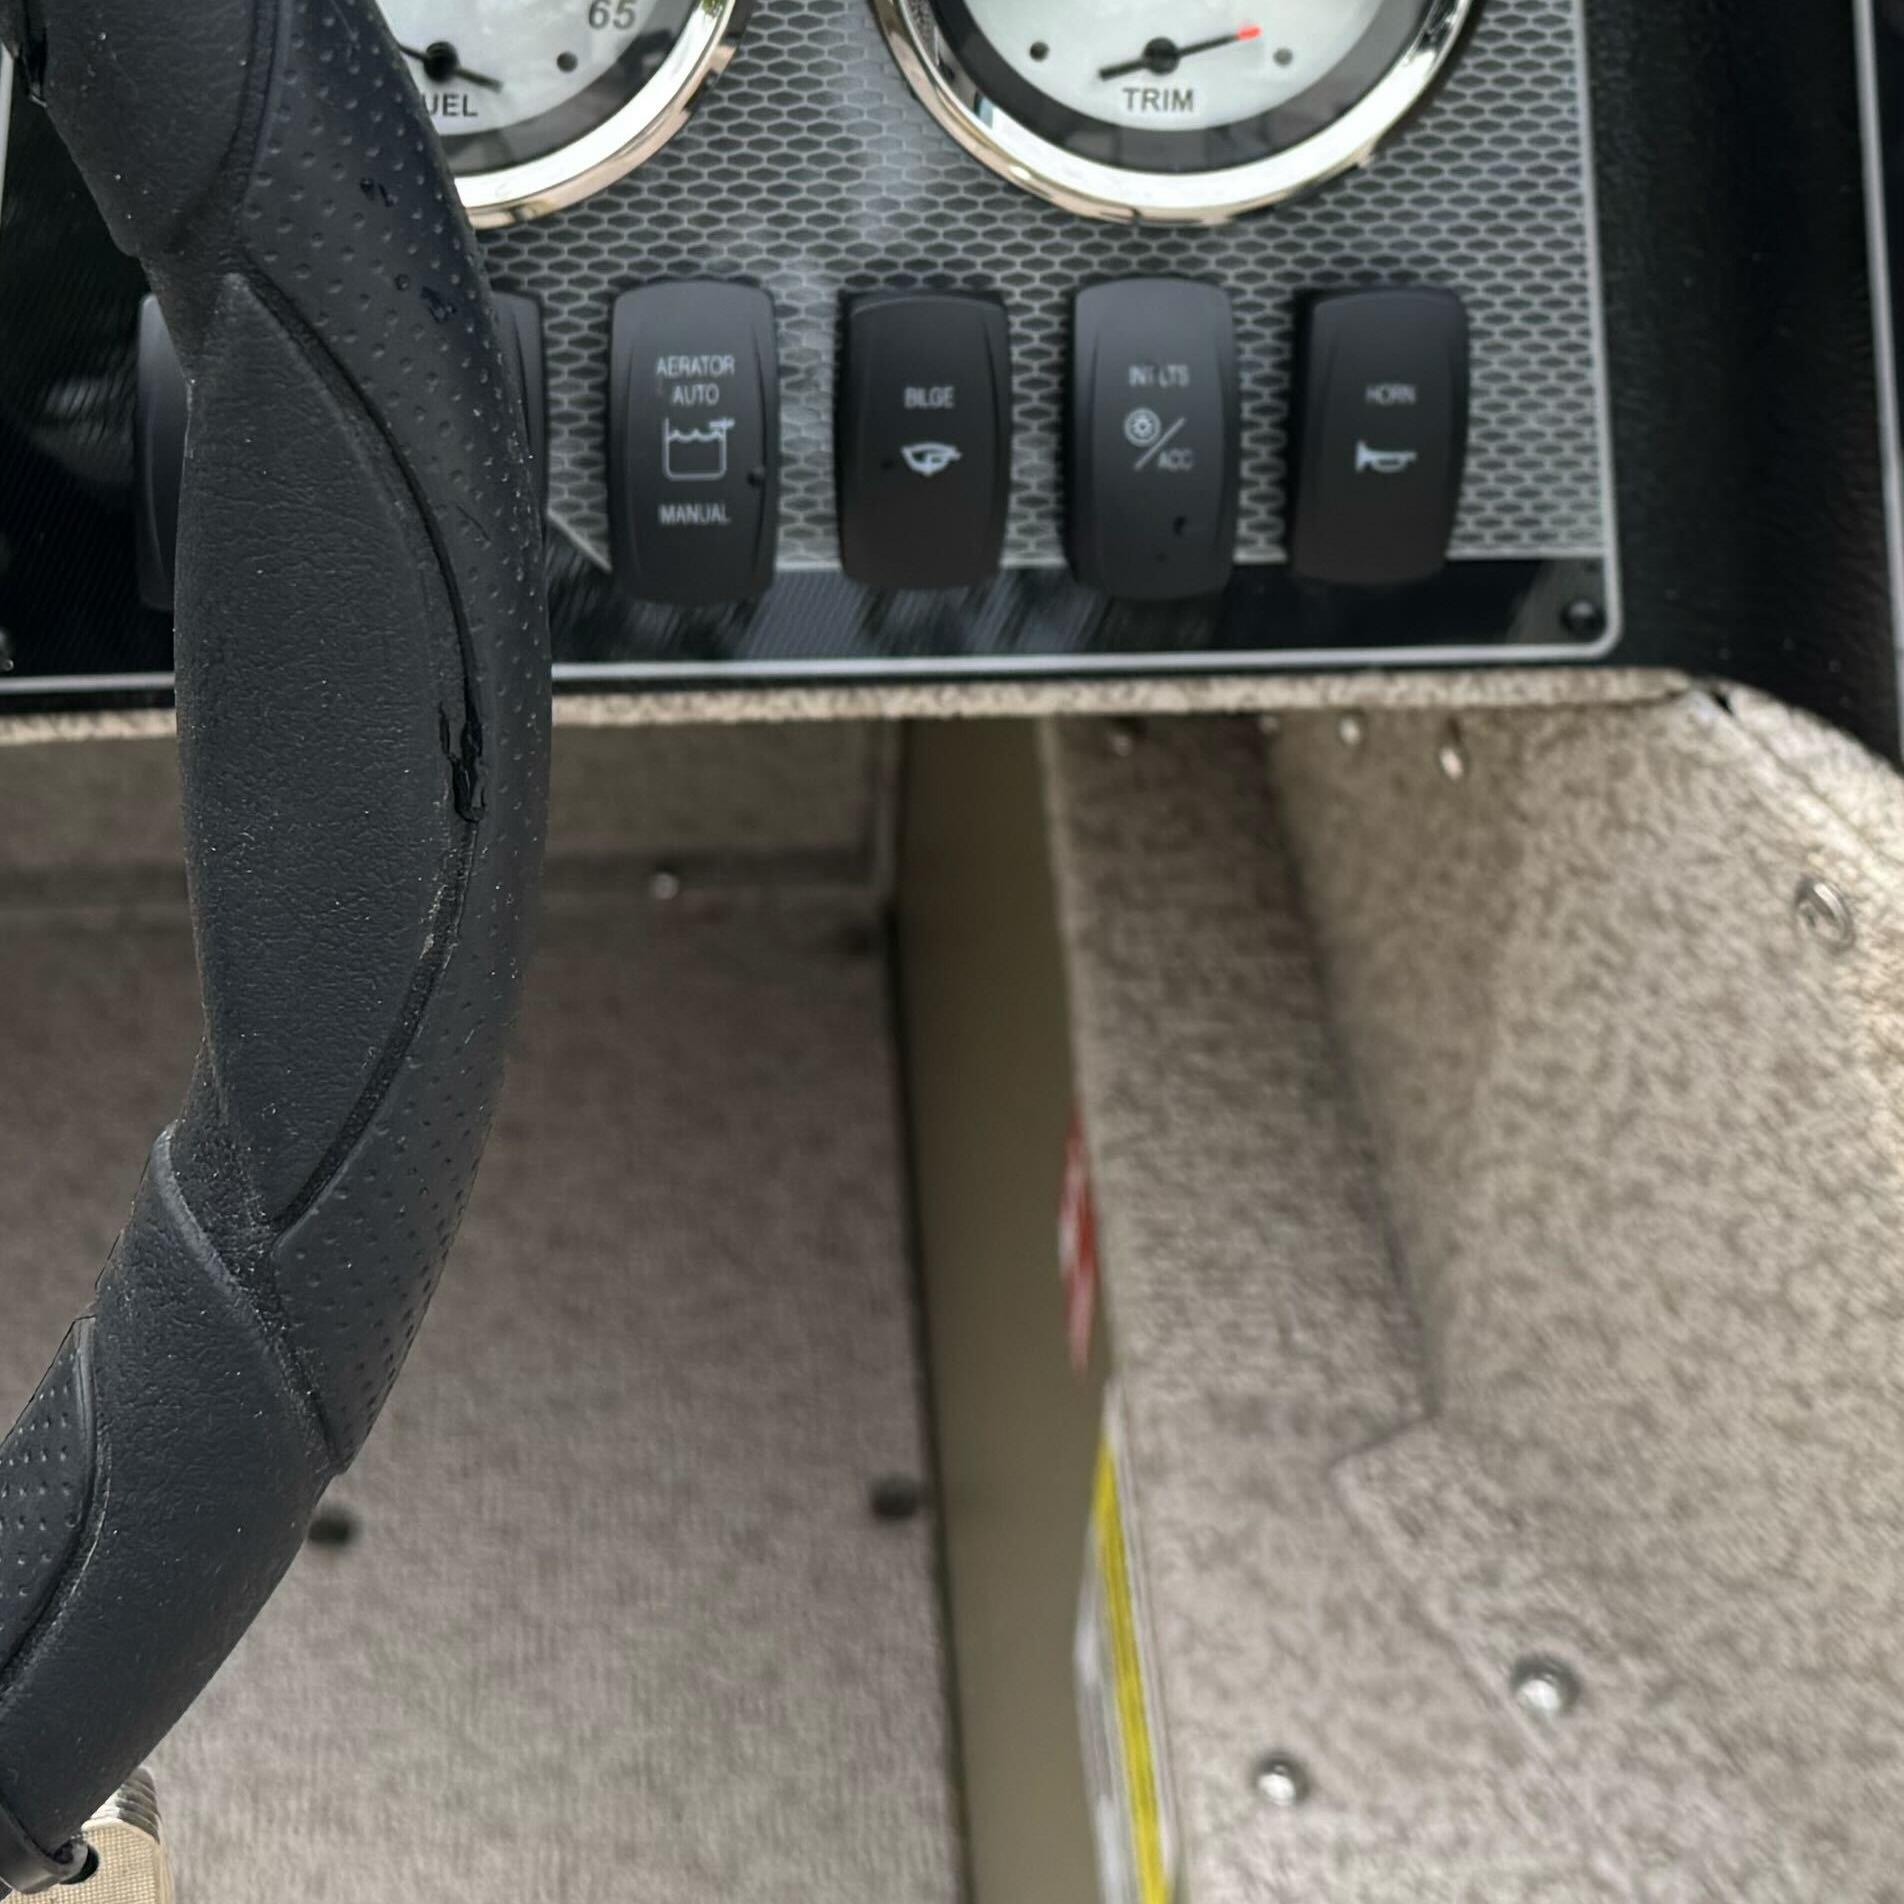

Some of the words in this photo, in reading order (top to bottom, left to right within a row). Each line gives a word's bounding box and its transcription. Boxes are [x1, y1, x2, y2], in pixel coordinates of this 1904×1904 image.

[427, 92, 480, 117] UEL
[1123, 87, 1195, 112] TRIM
[656, 354, 736, 378] AERATOR
[671, 382, 721, 407] AUTO
[903, 385, 955, 410] BILGE
[1364, 382, 1417, 407] HORN
[1157, 447, 1194, 472] ACC
[658, 502, 731, 526] MANUAL
